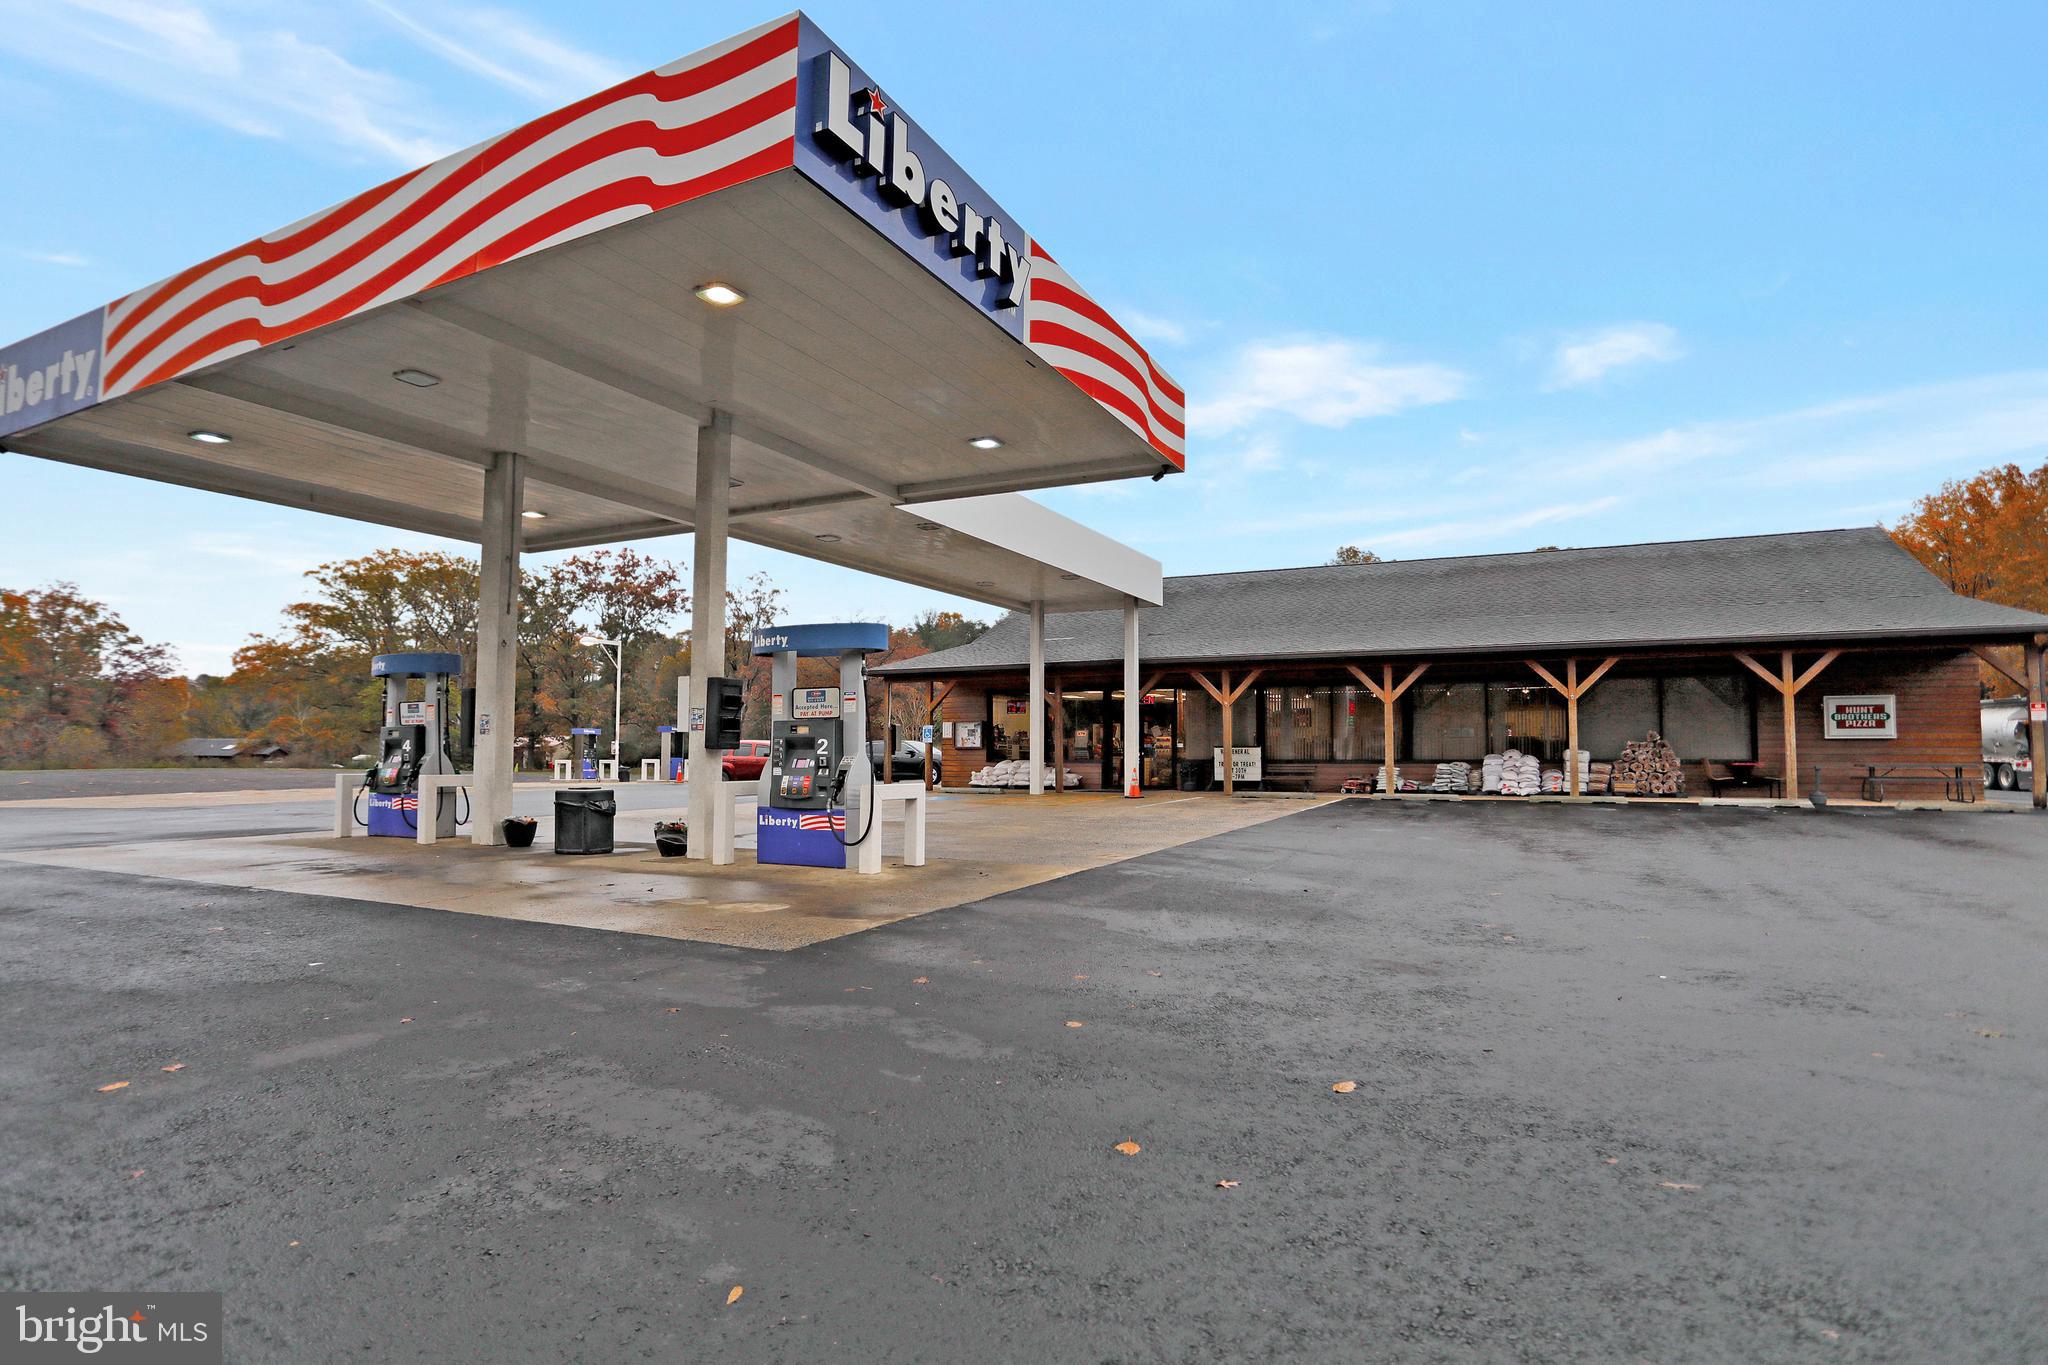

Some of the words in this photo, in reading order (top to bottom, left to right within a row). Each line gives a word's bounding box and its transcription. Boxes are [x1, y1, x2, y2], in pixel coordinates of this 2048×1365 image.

[824, 51, 1031, 307] Liberty
[0, 349, 96, 416] iberty
[754, 635, 788, 648] Liberty
[1143, 695, 1155, 705] EN
[1845, 706, 1874, 714] HUNT
[1834, 713, 1887, 721] BROTHERS
[402, 740, 411, 752] 4
[817, 738, 829, 755] 2
[369, 798, 392, 809] Liberty
[759, 815, 798, 829] Liberty
